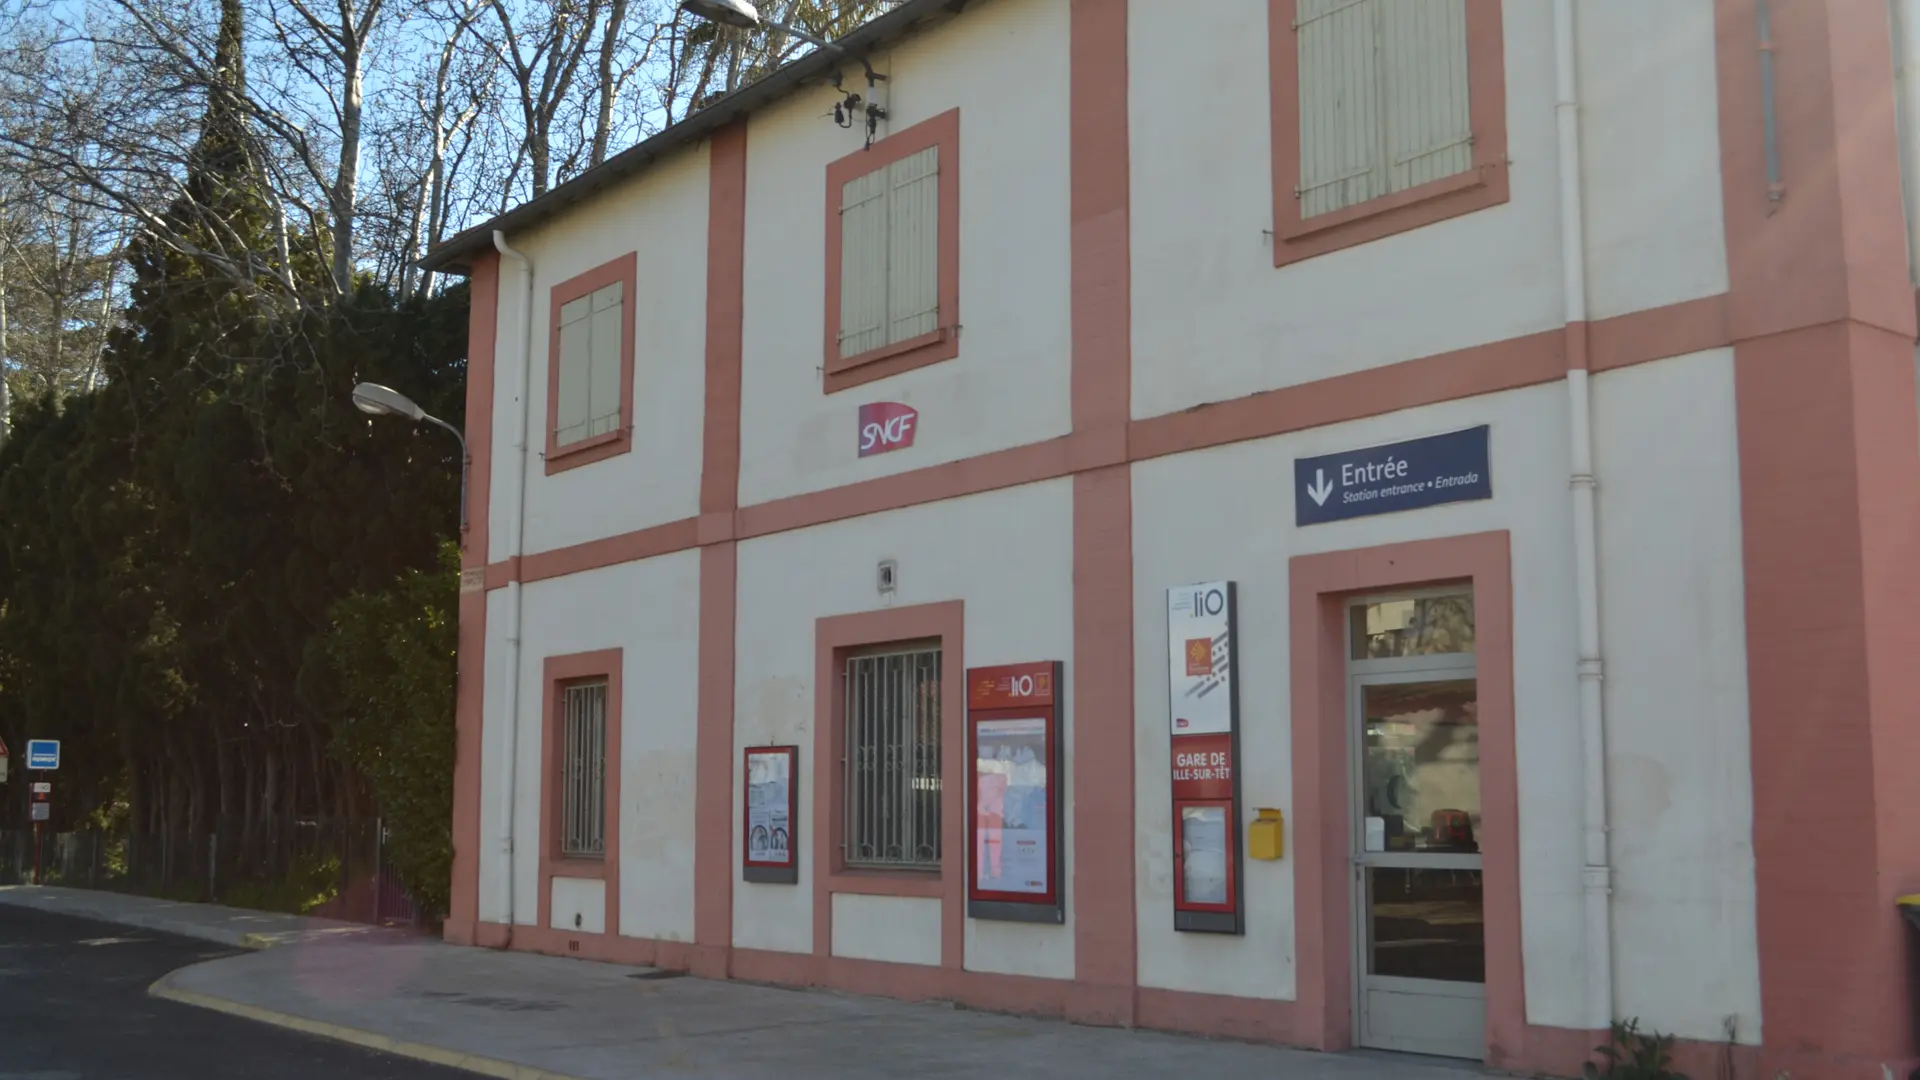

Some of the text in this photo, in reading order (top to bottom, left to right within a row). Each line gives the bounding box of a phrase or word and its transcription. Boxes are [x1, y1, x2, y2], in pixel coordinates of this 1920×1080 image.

[861, 413, 915, 450] SNCF
[1341, 456, 1409, 487] Entrée
[1342, 472, 1479, 504] Station entrance Entrada
[1177, 752, 1226, 767] GARE DE
